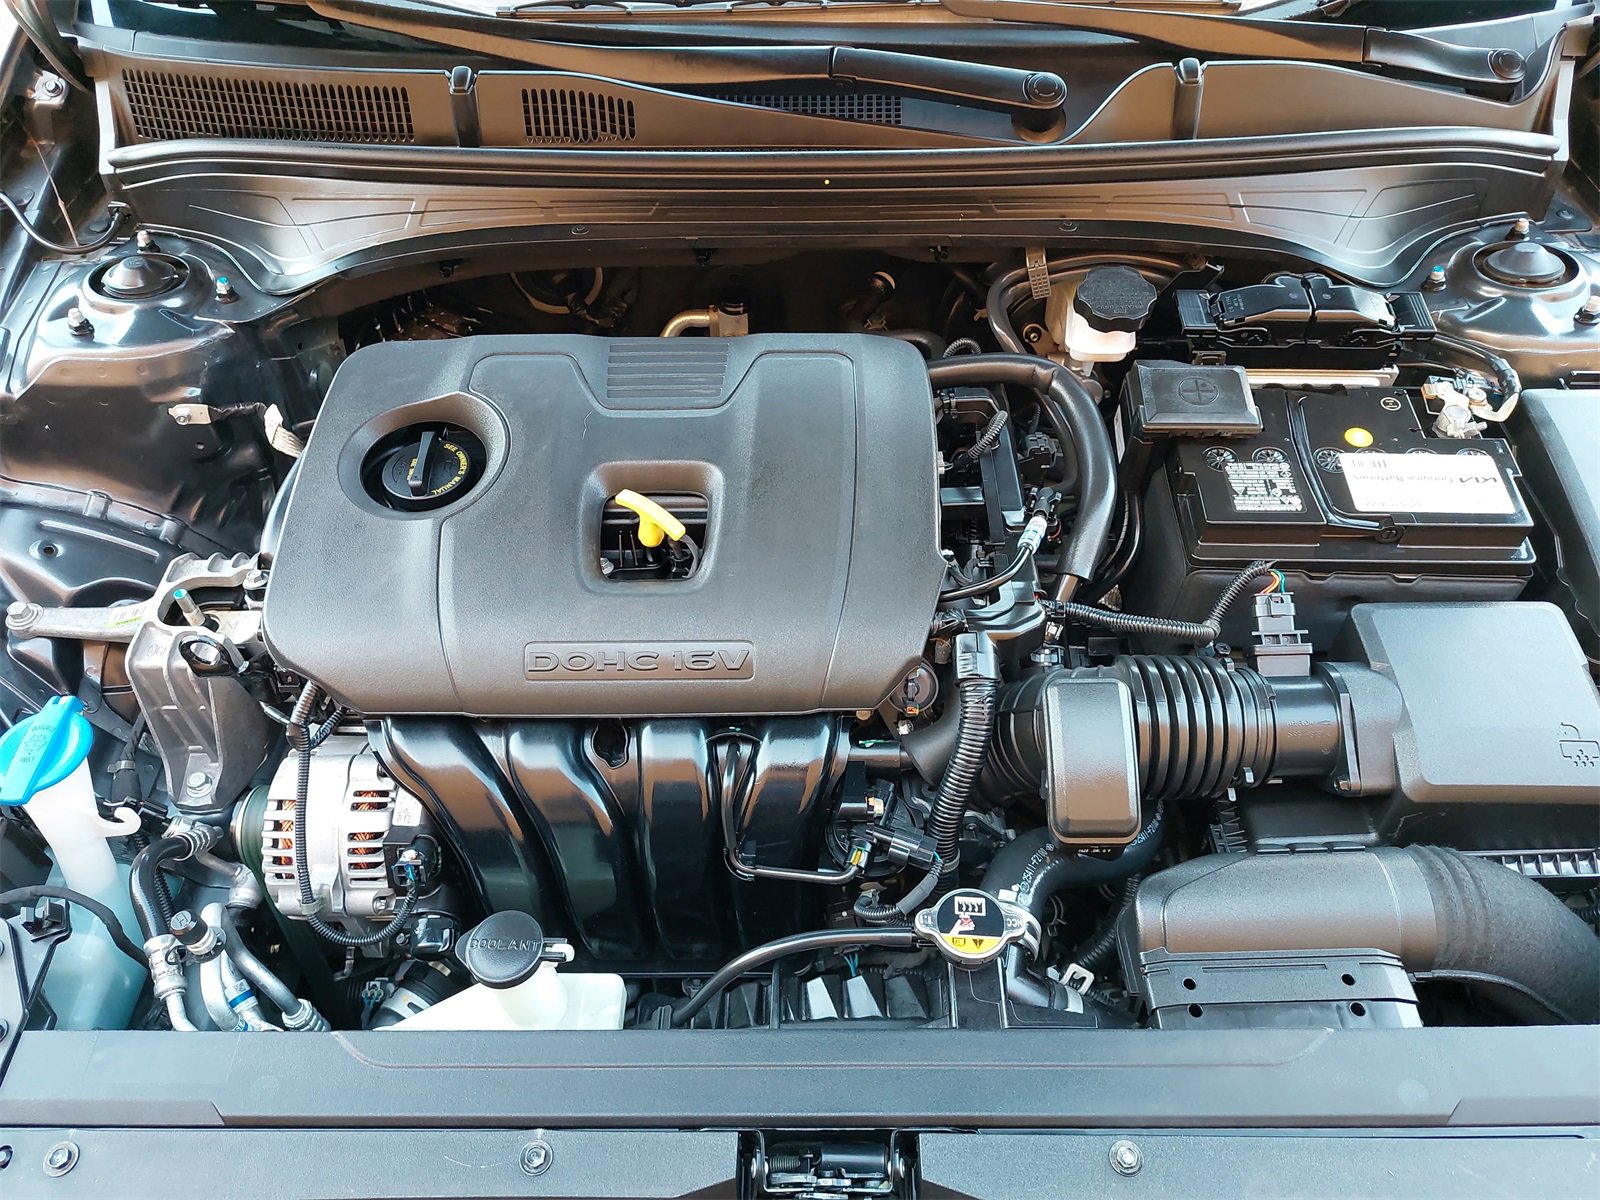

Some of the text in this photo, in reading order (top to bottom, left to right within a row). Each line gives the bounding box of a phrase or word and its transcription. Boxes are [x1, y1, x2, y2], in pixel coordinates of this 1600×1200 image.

[431, 444, 468, 495] SEE OWNER'S MANUAL
[1459, 476, 1498, 484] KIA
[527, 649, 750, 672] DOHC 16V
[469, 937, 541, 952] COOLANT
